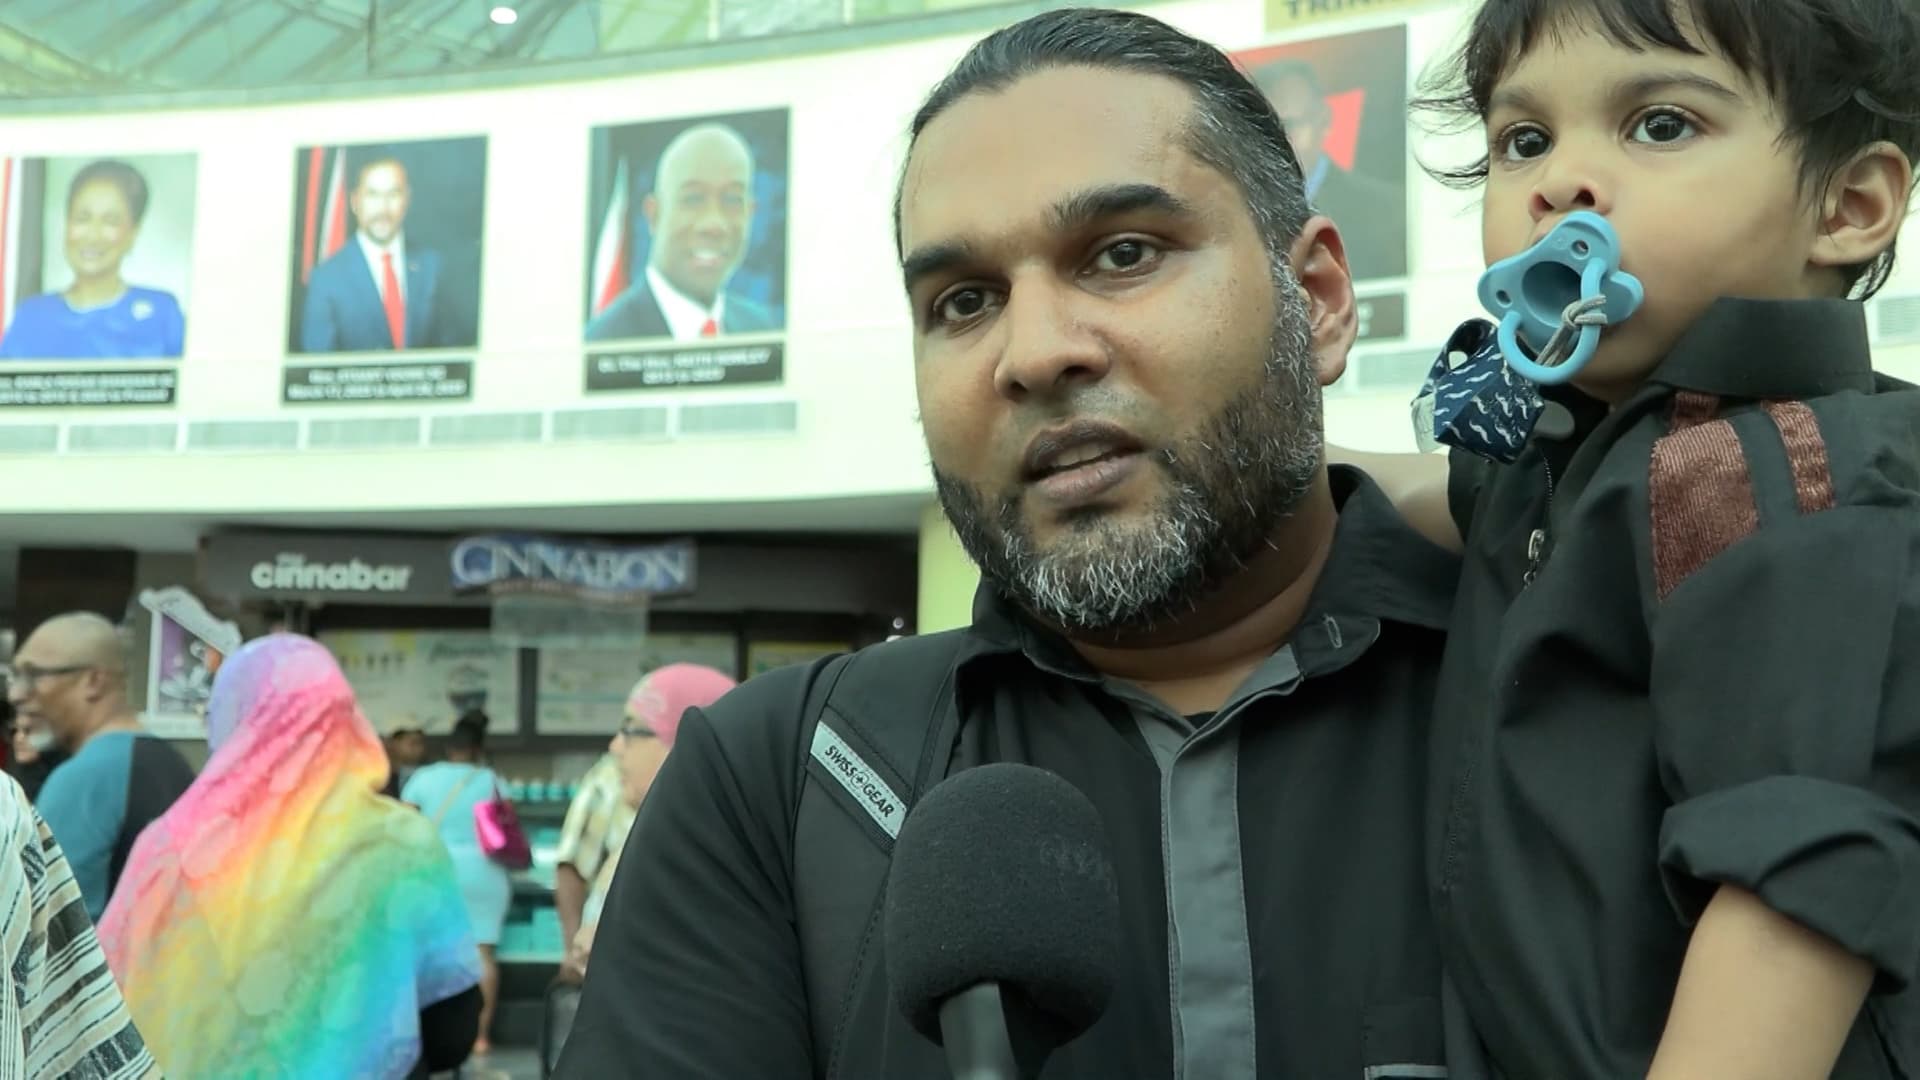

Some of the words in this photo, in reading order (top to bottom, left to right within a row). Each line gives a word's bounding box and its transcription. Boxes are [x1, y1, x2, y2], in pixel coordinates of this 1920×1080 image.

[251, 560, 410, 593] cinnabar
[453, 538, 688, 588] CINNABON
[824, 745, 857, 776] SWISS
[863, 784, 895, 818] GEAR
